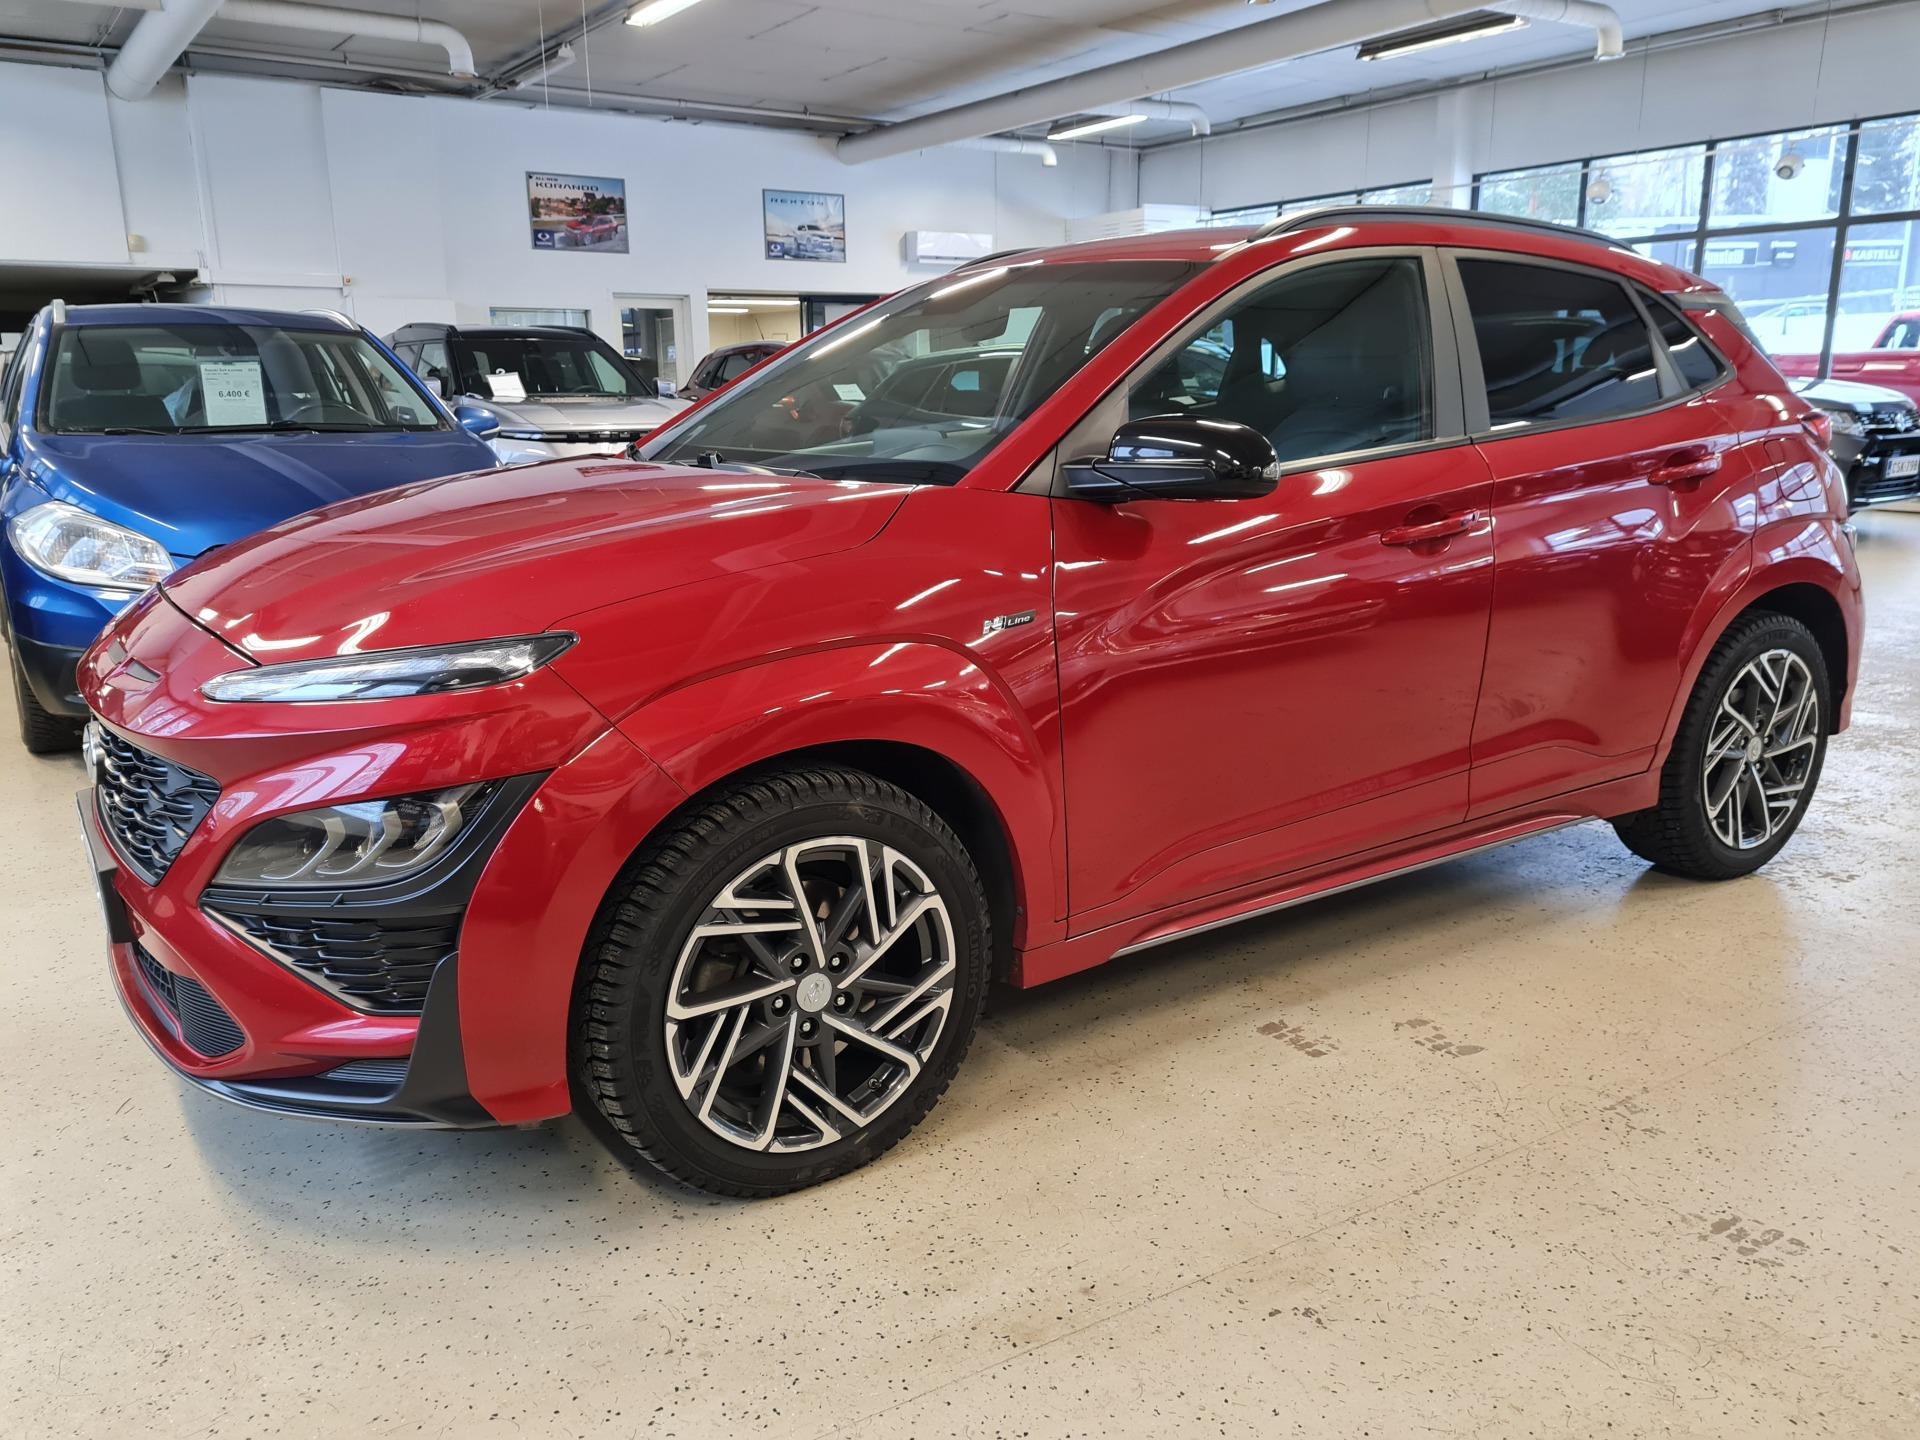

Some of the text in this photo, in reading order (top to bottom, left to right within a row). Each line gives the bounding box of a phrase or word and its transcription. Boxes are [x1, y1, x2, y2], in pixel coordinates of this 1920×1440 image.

[535, 181, 599, 192] KORANDO
[218, 390, 251, 398] 6.400 €
[983, 615, 1031, 635] N Line
